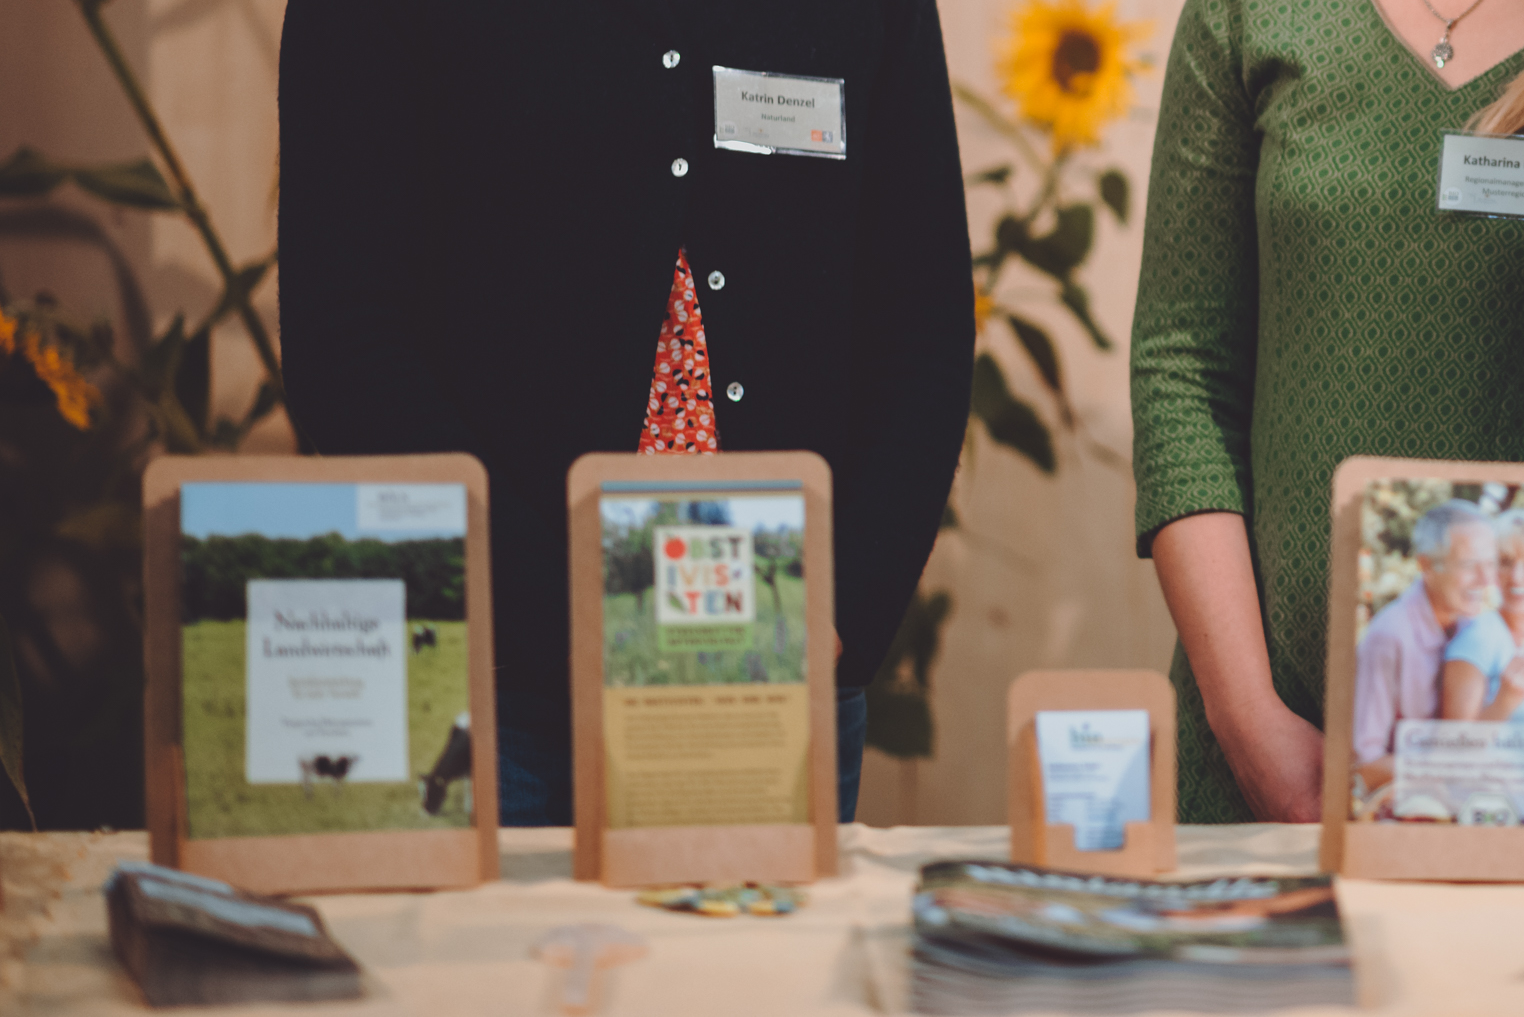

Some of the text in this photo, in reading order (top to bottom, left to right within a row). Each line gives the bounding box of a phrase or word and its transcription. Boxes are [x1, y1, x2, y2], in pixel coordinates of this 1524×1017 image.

[741, 90, 815, 109] Katrin Denzel
[761, 112, 796, 124] Naturland
[1463, 154, 1520, 170] Katharina
